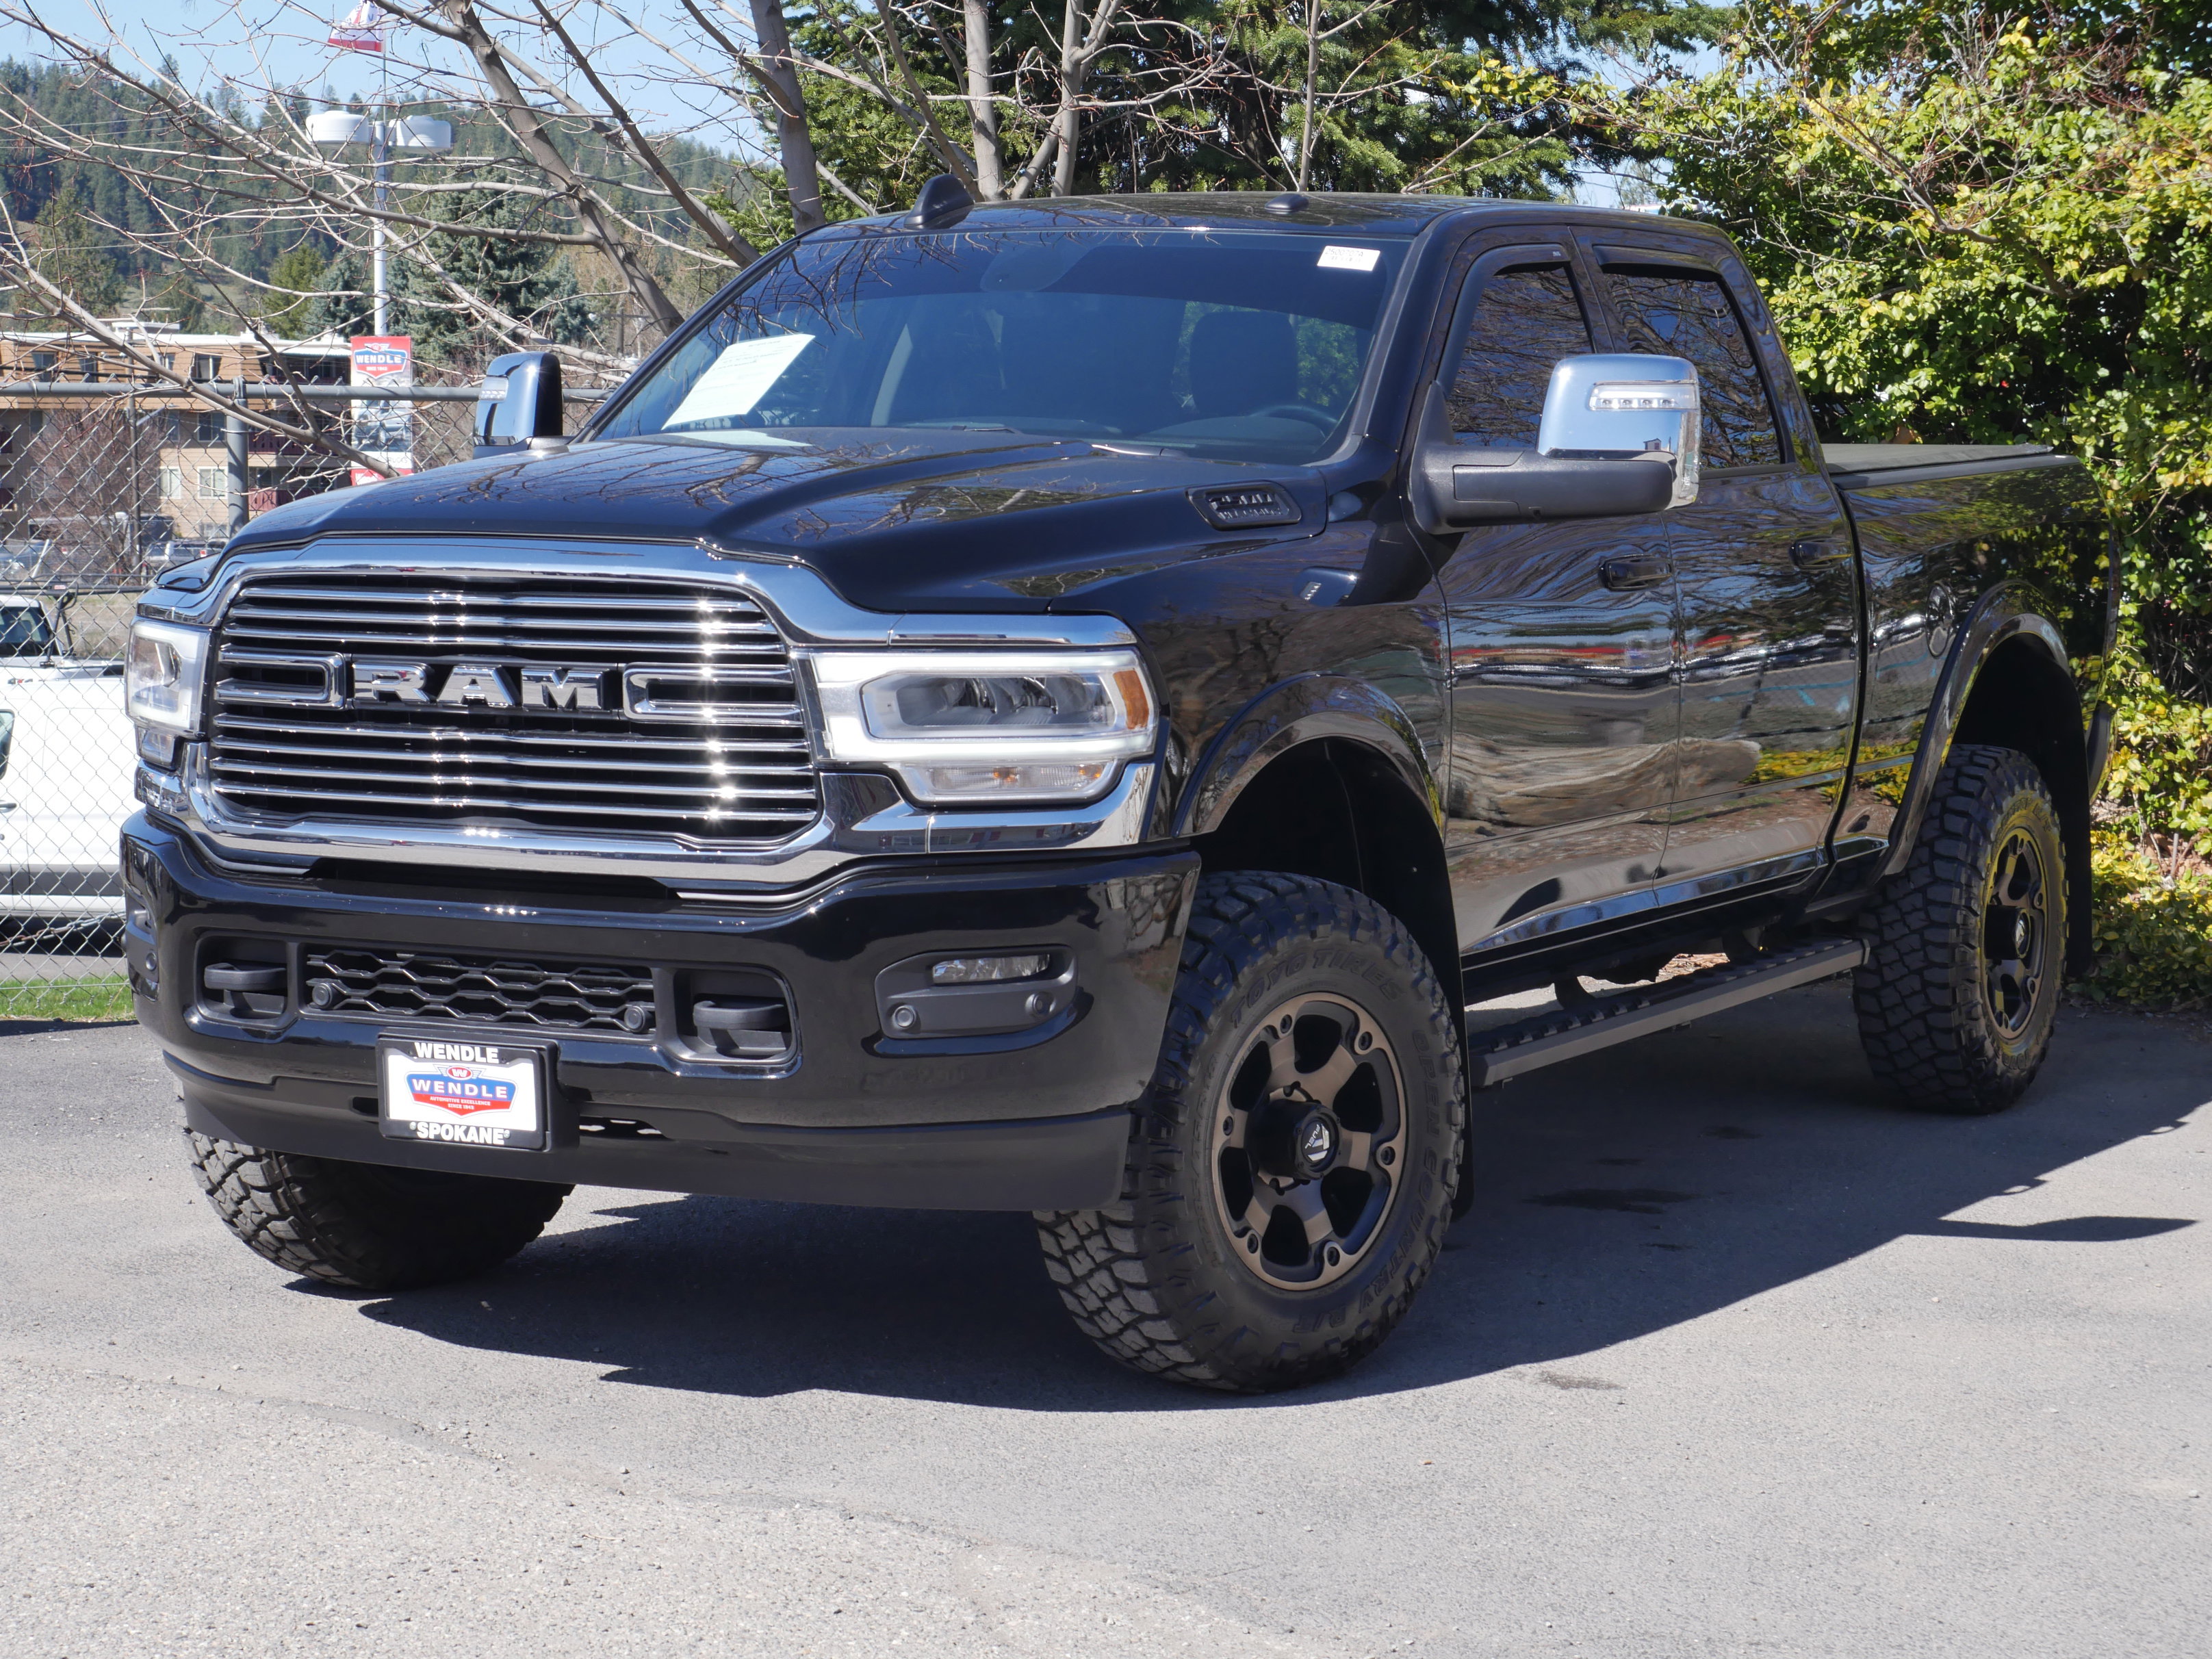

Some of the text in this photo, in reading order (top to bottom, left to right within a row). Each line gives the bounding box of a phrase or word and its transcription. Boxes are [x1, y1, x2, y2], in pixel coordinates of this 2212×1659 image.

[356, 355, 402, 364] WENDLE
[352, 661, 609, 710] RAM
[1231, 947, 1403, 1029] TOYO TIRES
[414, 1042, 499, 1064] WENDLE
[452, 1068, 467, 1078] W
[1412, 1029, 1440, 1137] OPEN
[412, 1079, 508, 1098] WENDLE
[417, 1122, 505, 1145] SPOKANE
[1304, 1124, 1320, 1149] FUEL
[1359, 1146, 1437, 1313] COUNTRY
